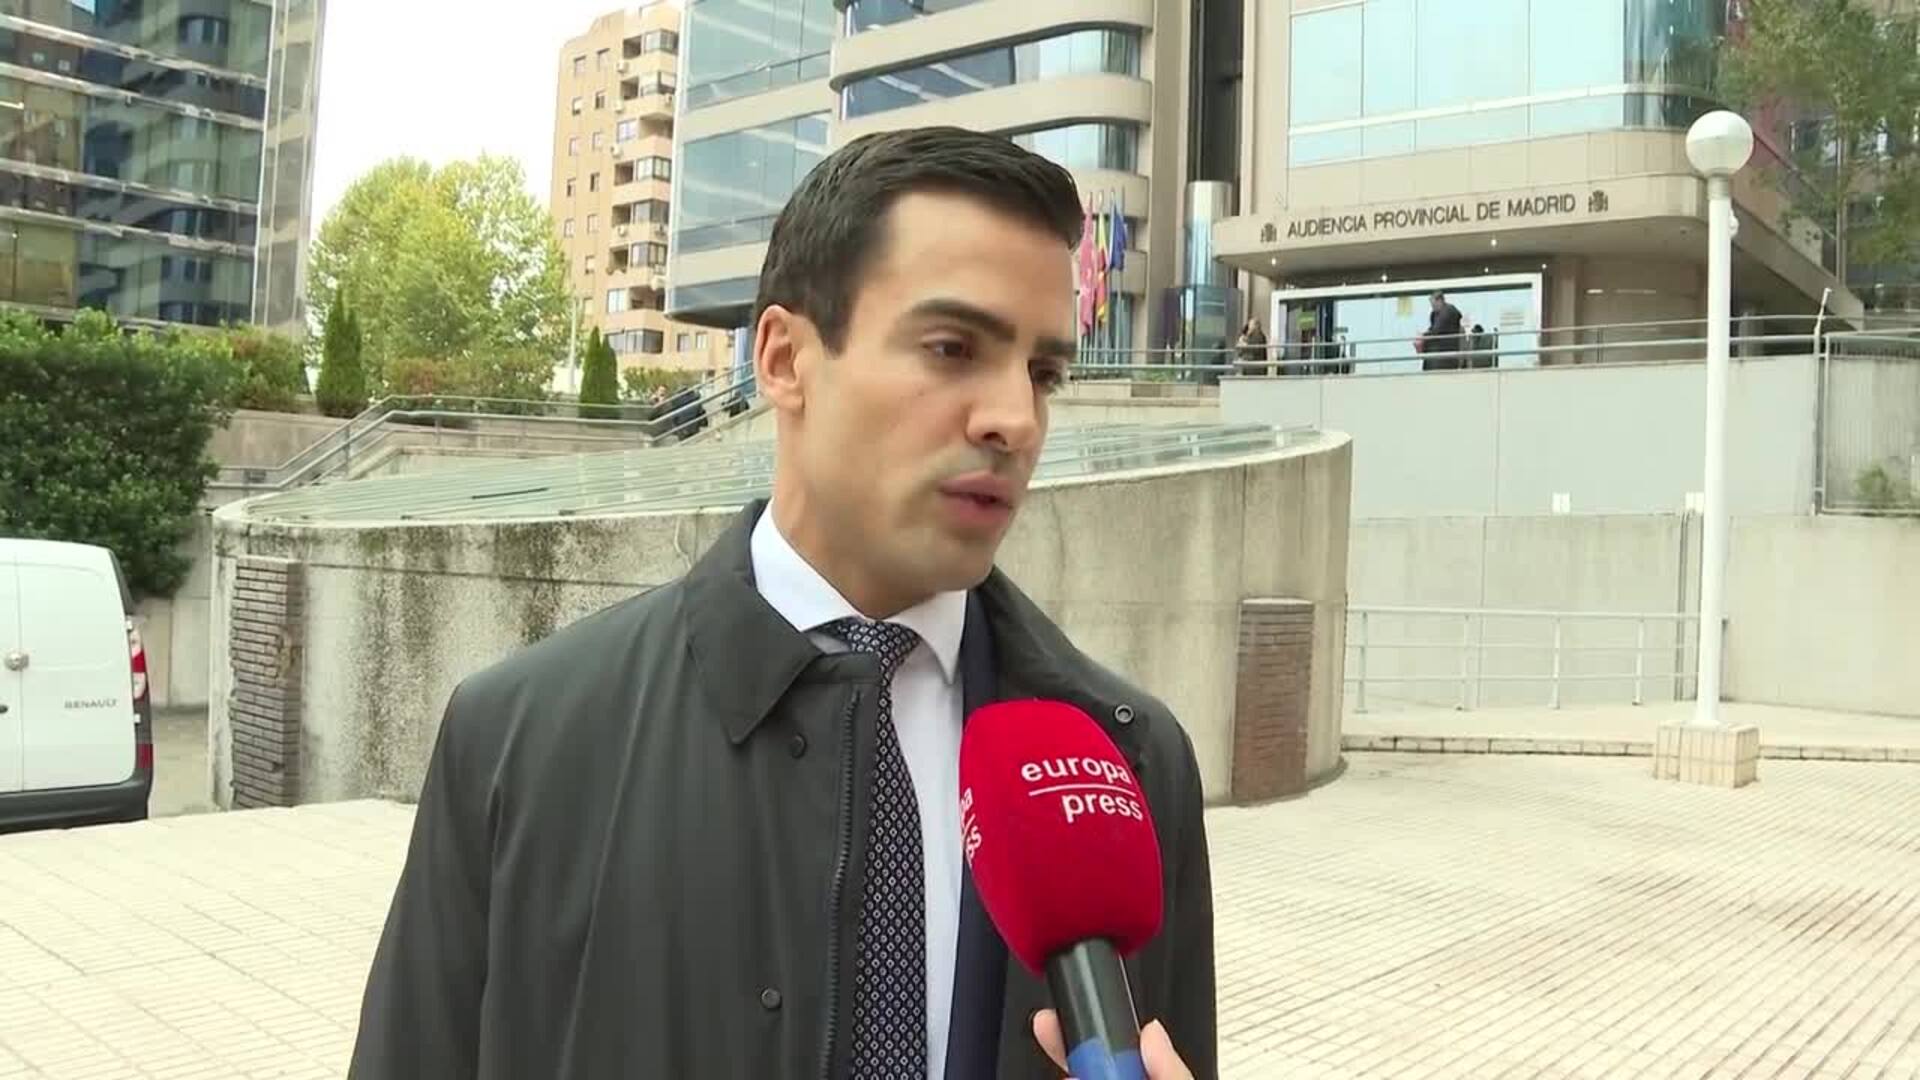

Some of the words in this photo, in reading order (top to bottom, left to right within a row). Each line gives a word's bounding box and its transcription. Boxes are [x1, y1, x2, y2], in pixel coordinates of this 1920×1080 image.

[1287, 214, 1367, 239] AUDIENCIA
[1373, 204, 1471, 231] PROVINCIAL
[1476, 200, 1500, 221] DE
[1507, 193, 1576, 217] MADRID
[1020, 756, 1132, 785] europa
[1061, 792, 1143, 823] press
